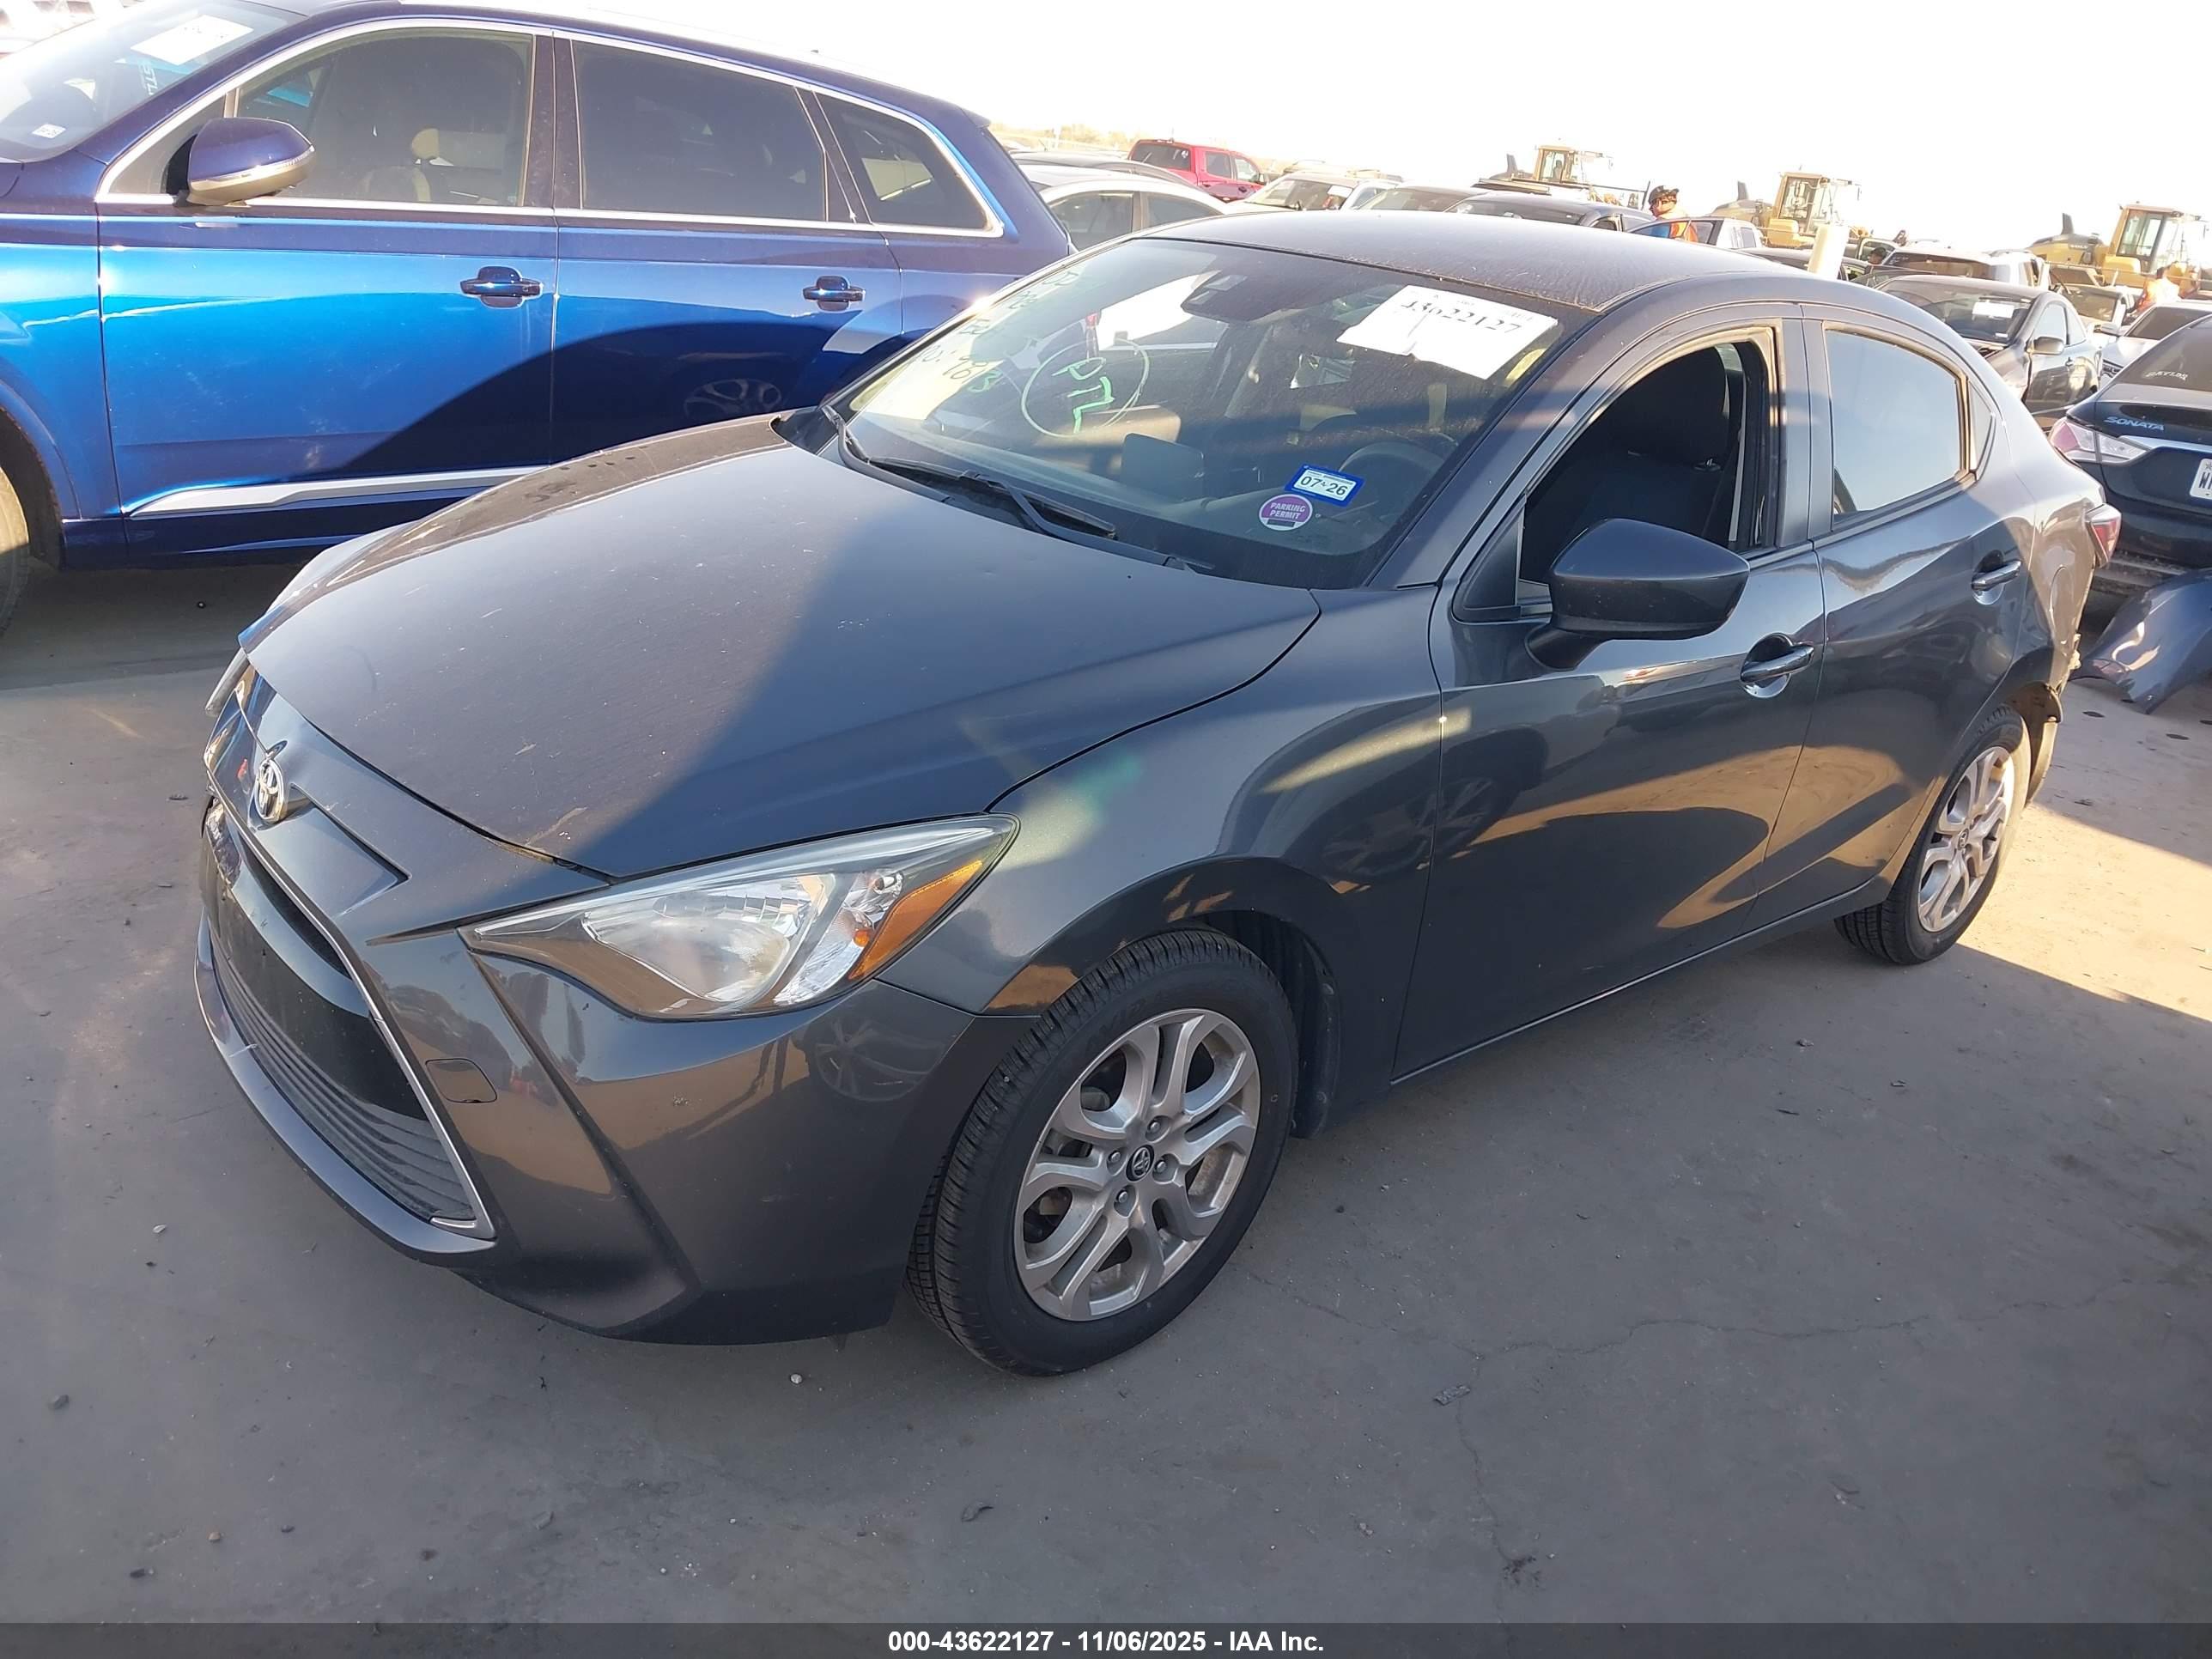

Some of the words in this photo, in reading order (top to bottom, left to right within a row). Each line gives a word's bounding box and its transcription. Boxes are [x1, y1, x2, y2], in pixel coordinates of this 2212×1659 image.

[2103, 416, 2165, 431] SONATA
[1270, 502, 1306, 513] PARKING
[1269, 509, 1302, 520] PERMIT
